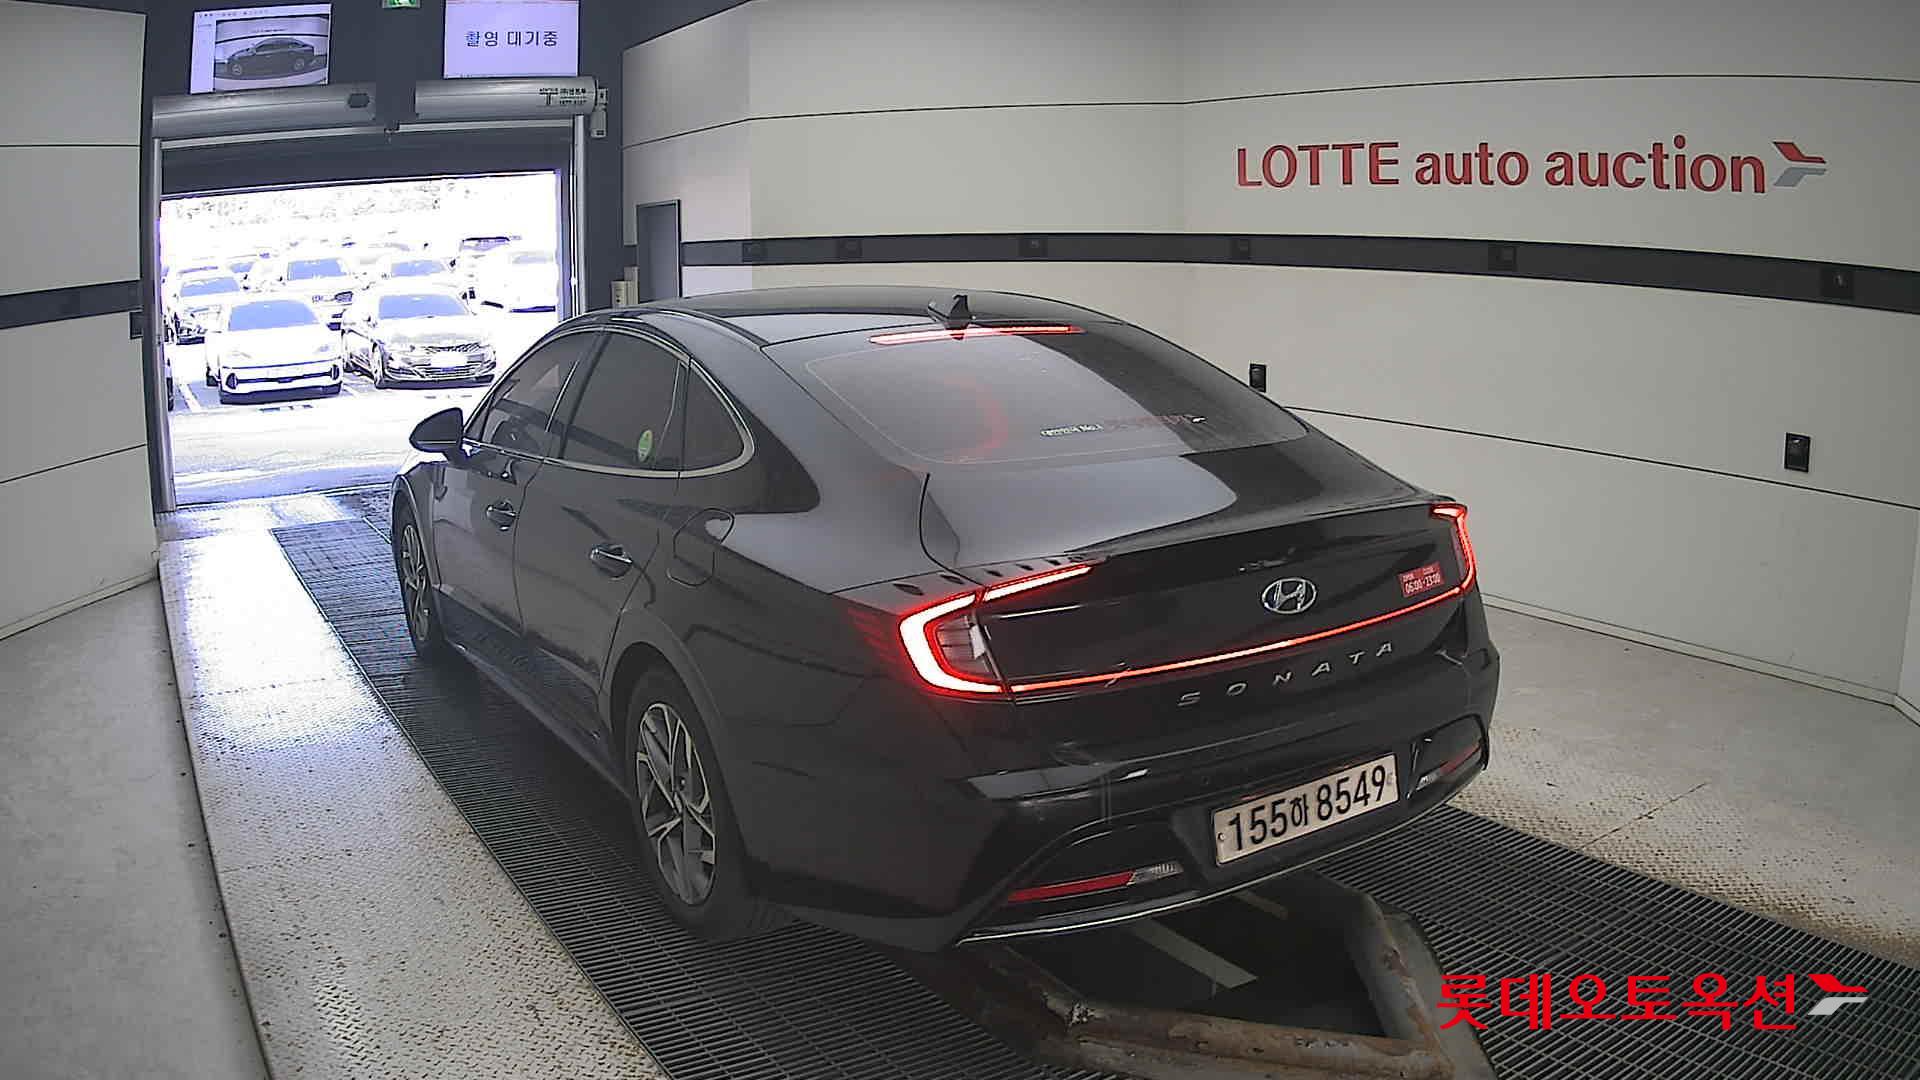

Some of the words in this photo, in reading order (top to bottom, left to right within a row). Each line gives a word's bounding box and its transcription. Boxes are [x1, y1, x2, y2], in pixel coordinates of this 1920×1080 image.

[507, 31, 558, 48] 대기중
[1237, 142, 1399, 188] LOTTE
[1415, 142, 1529, 187] auto
[1545, 136, 1765, 193] auction
[1177, 641, 1394, 706] SONATA
[1317, 765, 1386, 821] 8549
